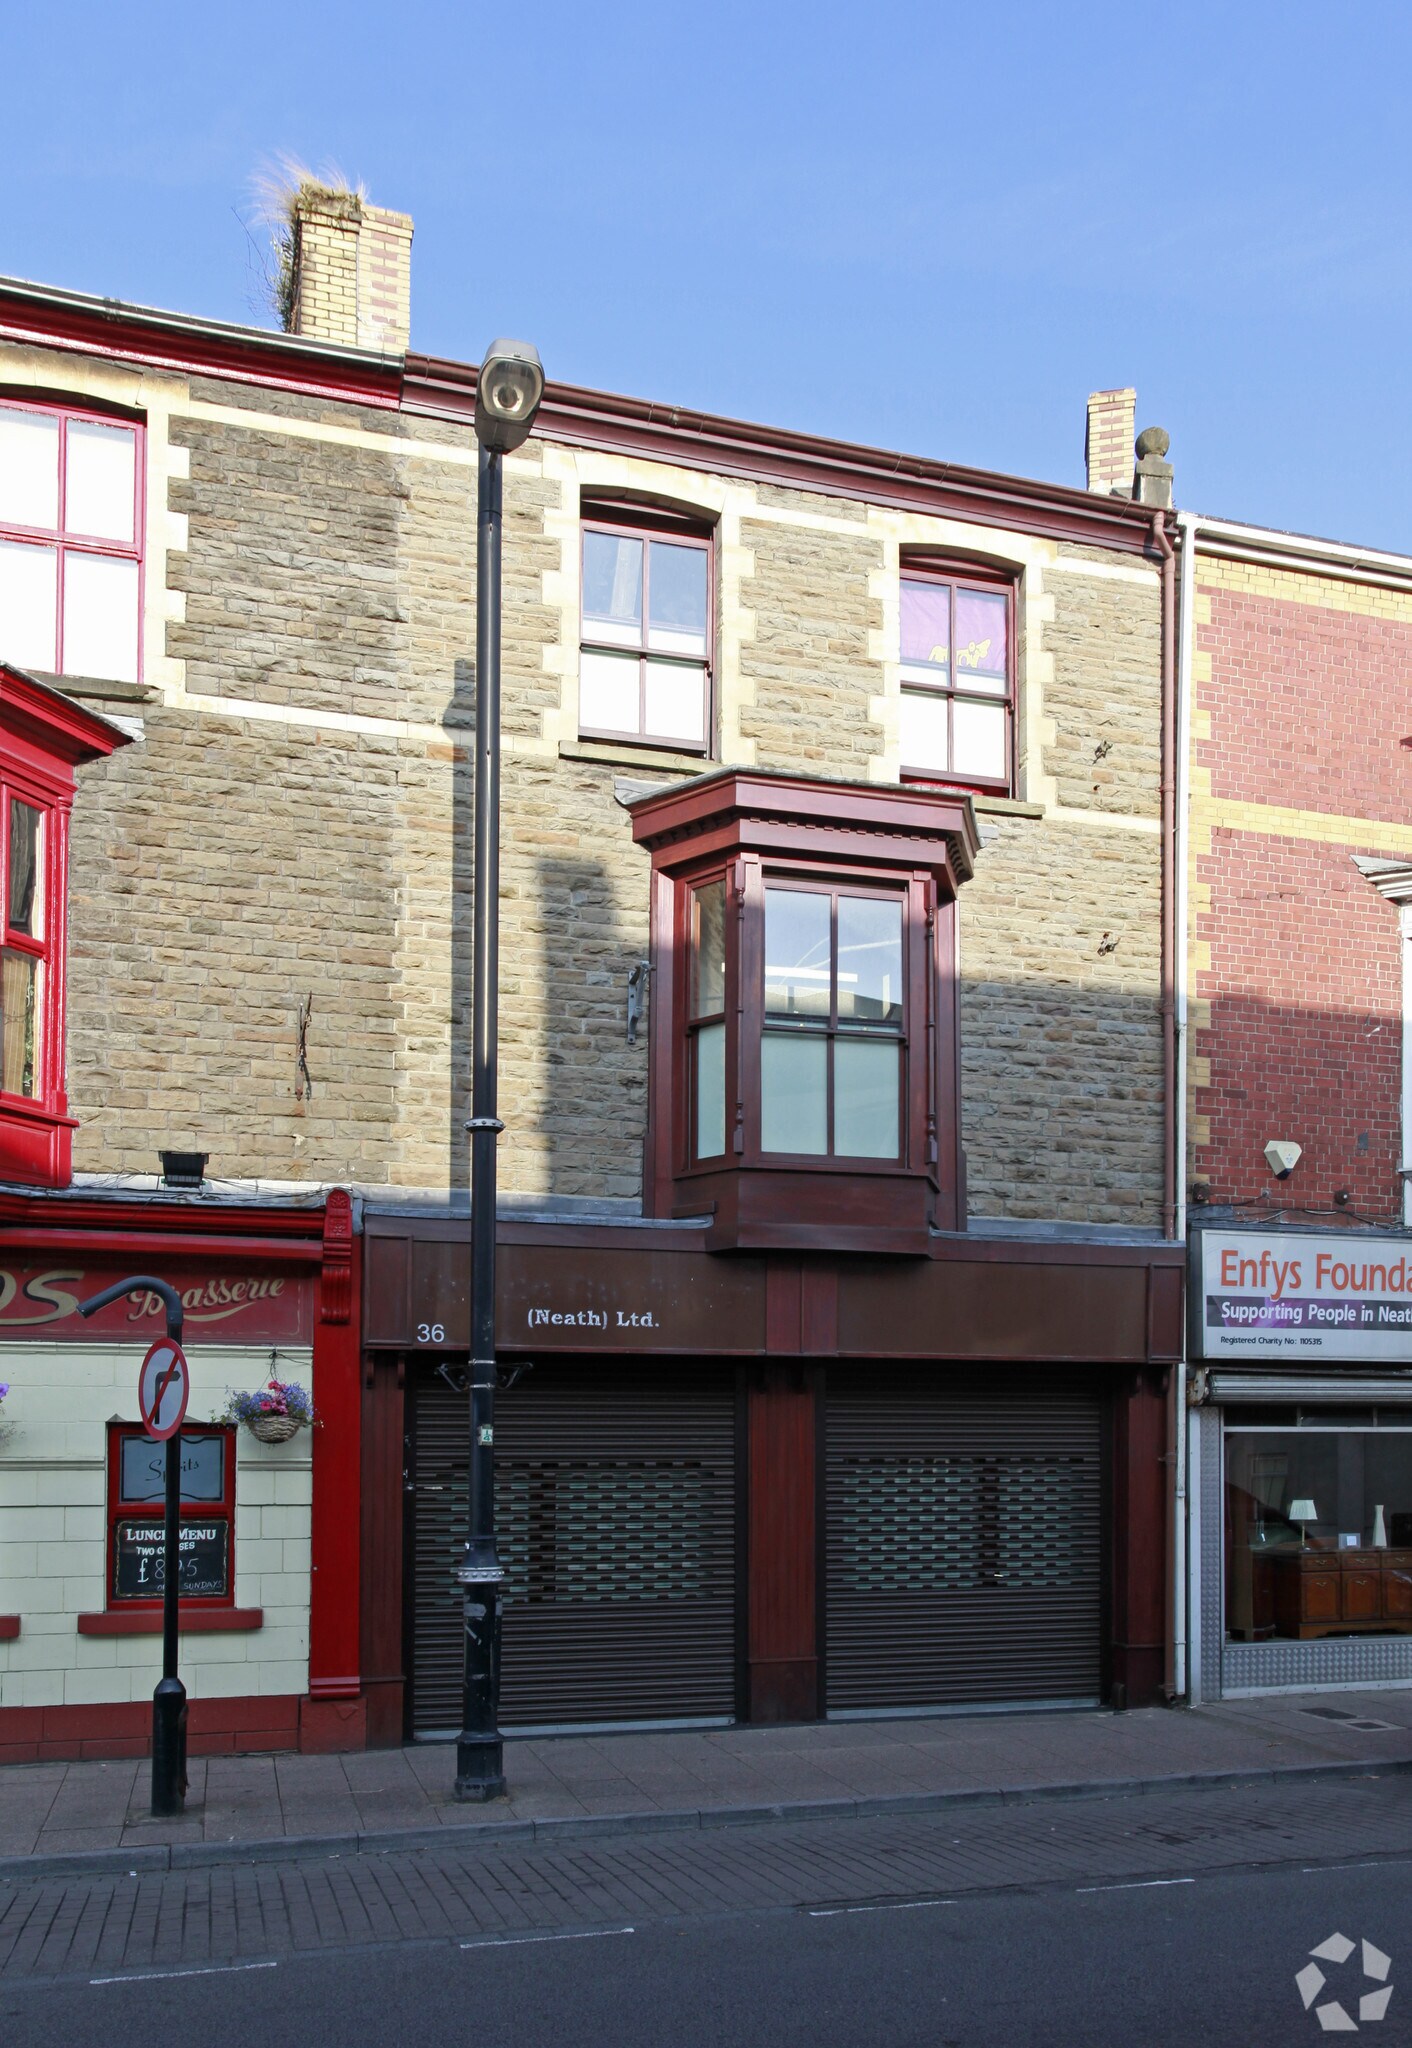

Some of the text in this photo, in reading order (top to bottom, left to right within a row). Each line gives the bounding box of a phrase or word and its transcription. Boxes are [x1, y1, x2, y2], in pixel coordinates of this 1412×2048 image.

[1221, 1249, 1301, 1300] Enfys
[128, 1278, 285, 1320] Basserie
[527, 1309, 660, 1329] (Neath) Ltd.
[1221, 1301, 1302, 1325] Supporting
[1308, 1303, 1356, 1325] People
[1361, 1304, 1374, 1321] in
[416, 1323, 445, 1343] 36
[1220, 1336, 1256, 1346] Registered
[1258, 1336, 1282, 1346] Charity
[1284, 1337, 1297, 1345] No:
[179, 1528, 217, 1540] MENU
[136, 1546, 155, 1556] TWO
[183, 1580, 223, 1591] SUNDAYS
